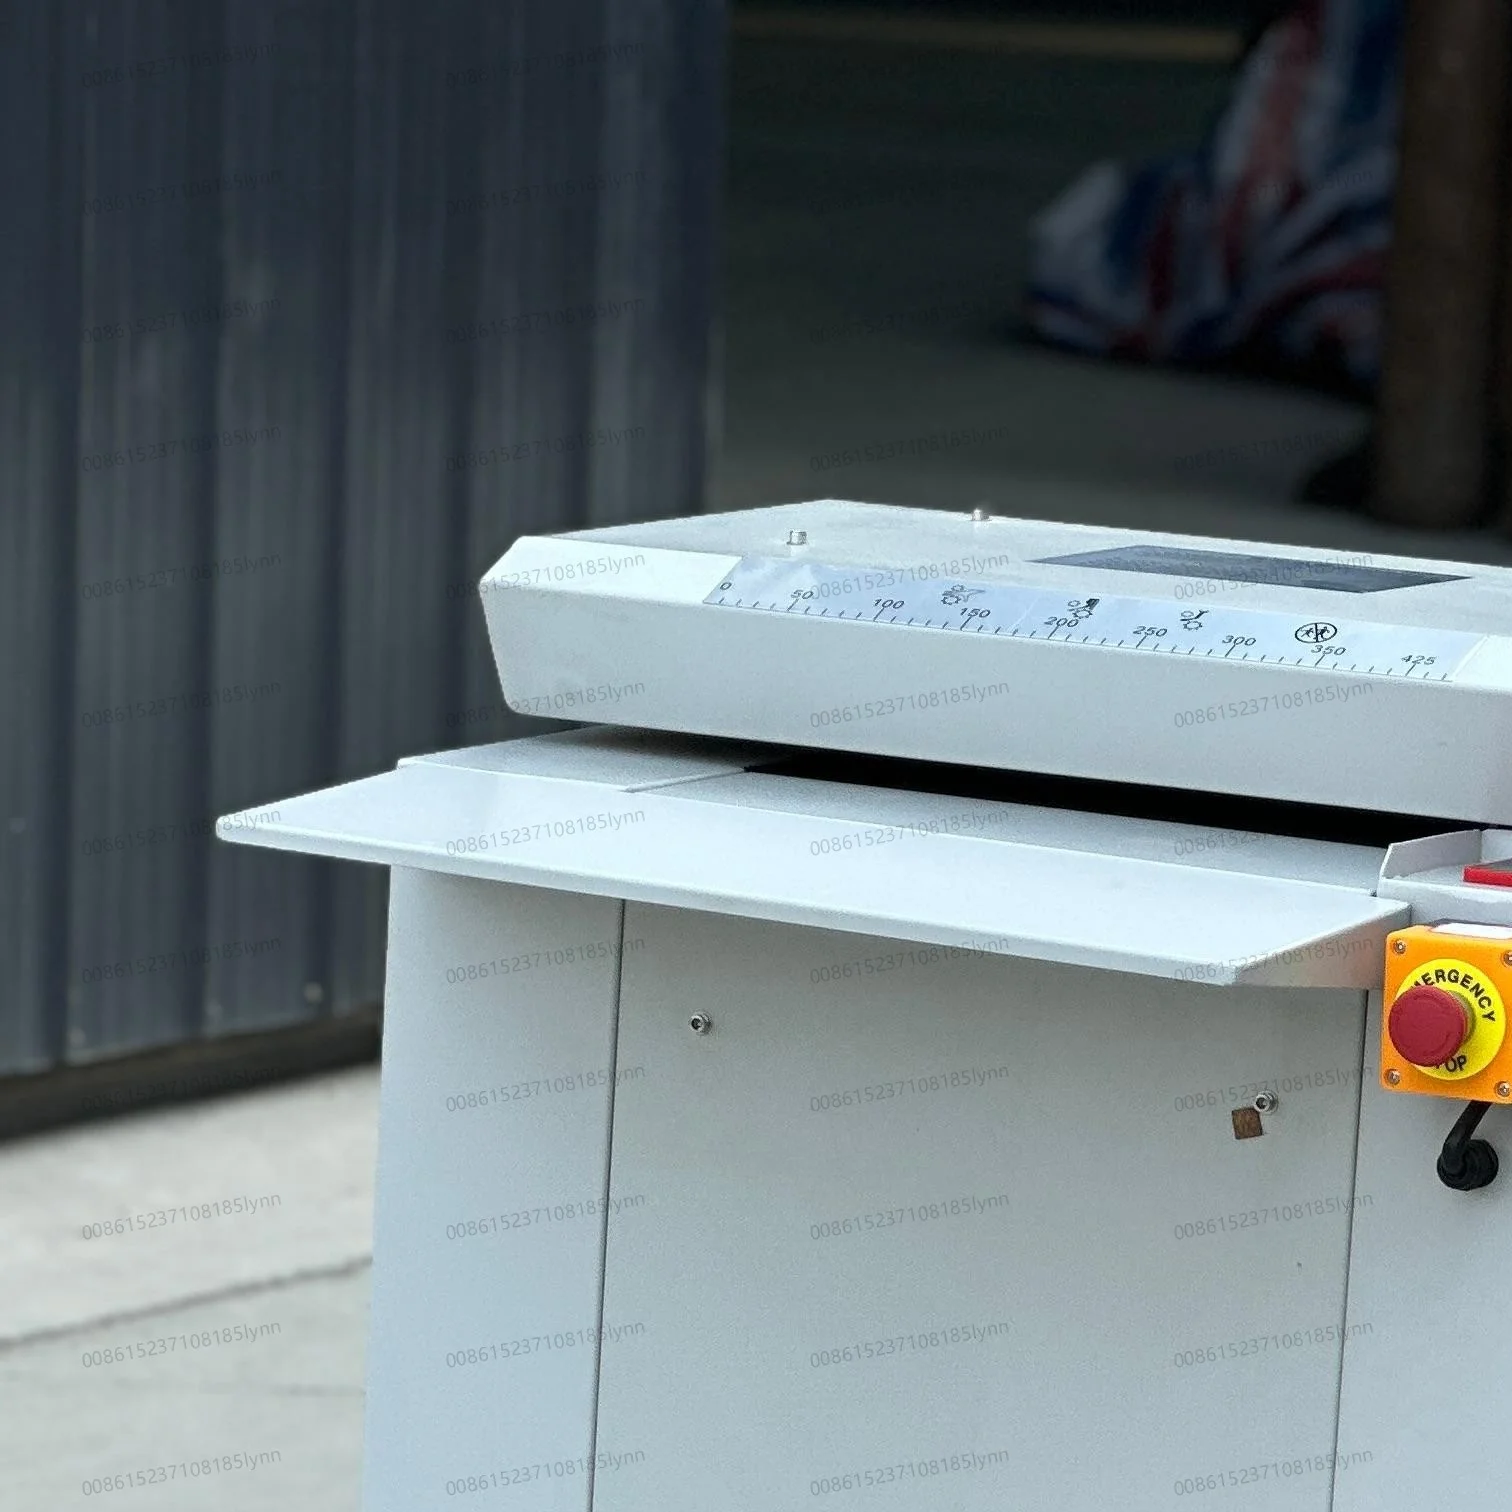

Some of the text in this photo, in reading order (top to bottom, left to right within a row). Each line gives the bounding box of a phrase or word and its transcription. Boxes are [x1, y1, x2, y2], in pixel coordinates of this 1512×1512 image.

[720, 581, 1437, 665] 0 50 100 150 200 250 300 350 425
[1411, 969, 1496, 1022] ERGENCY
[1434, 1055, 1467, 1073] OP
